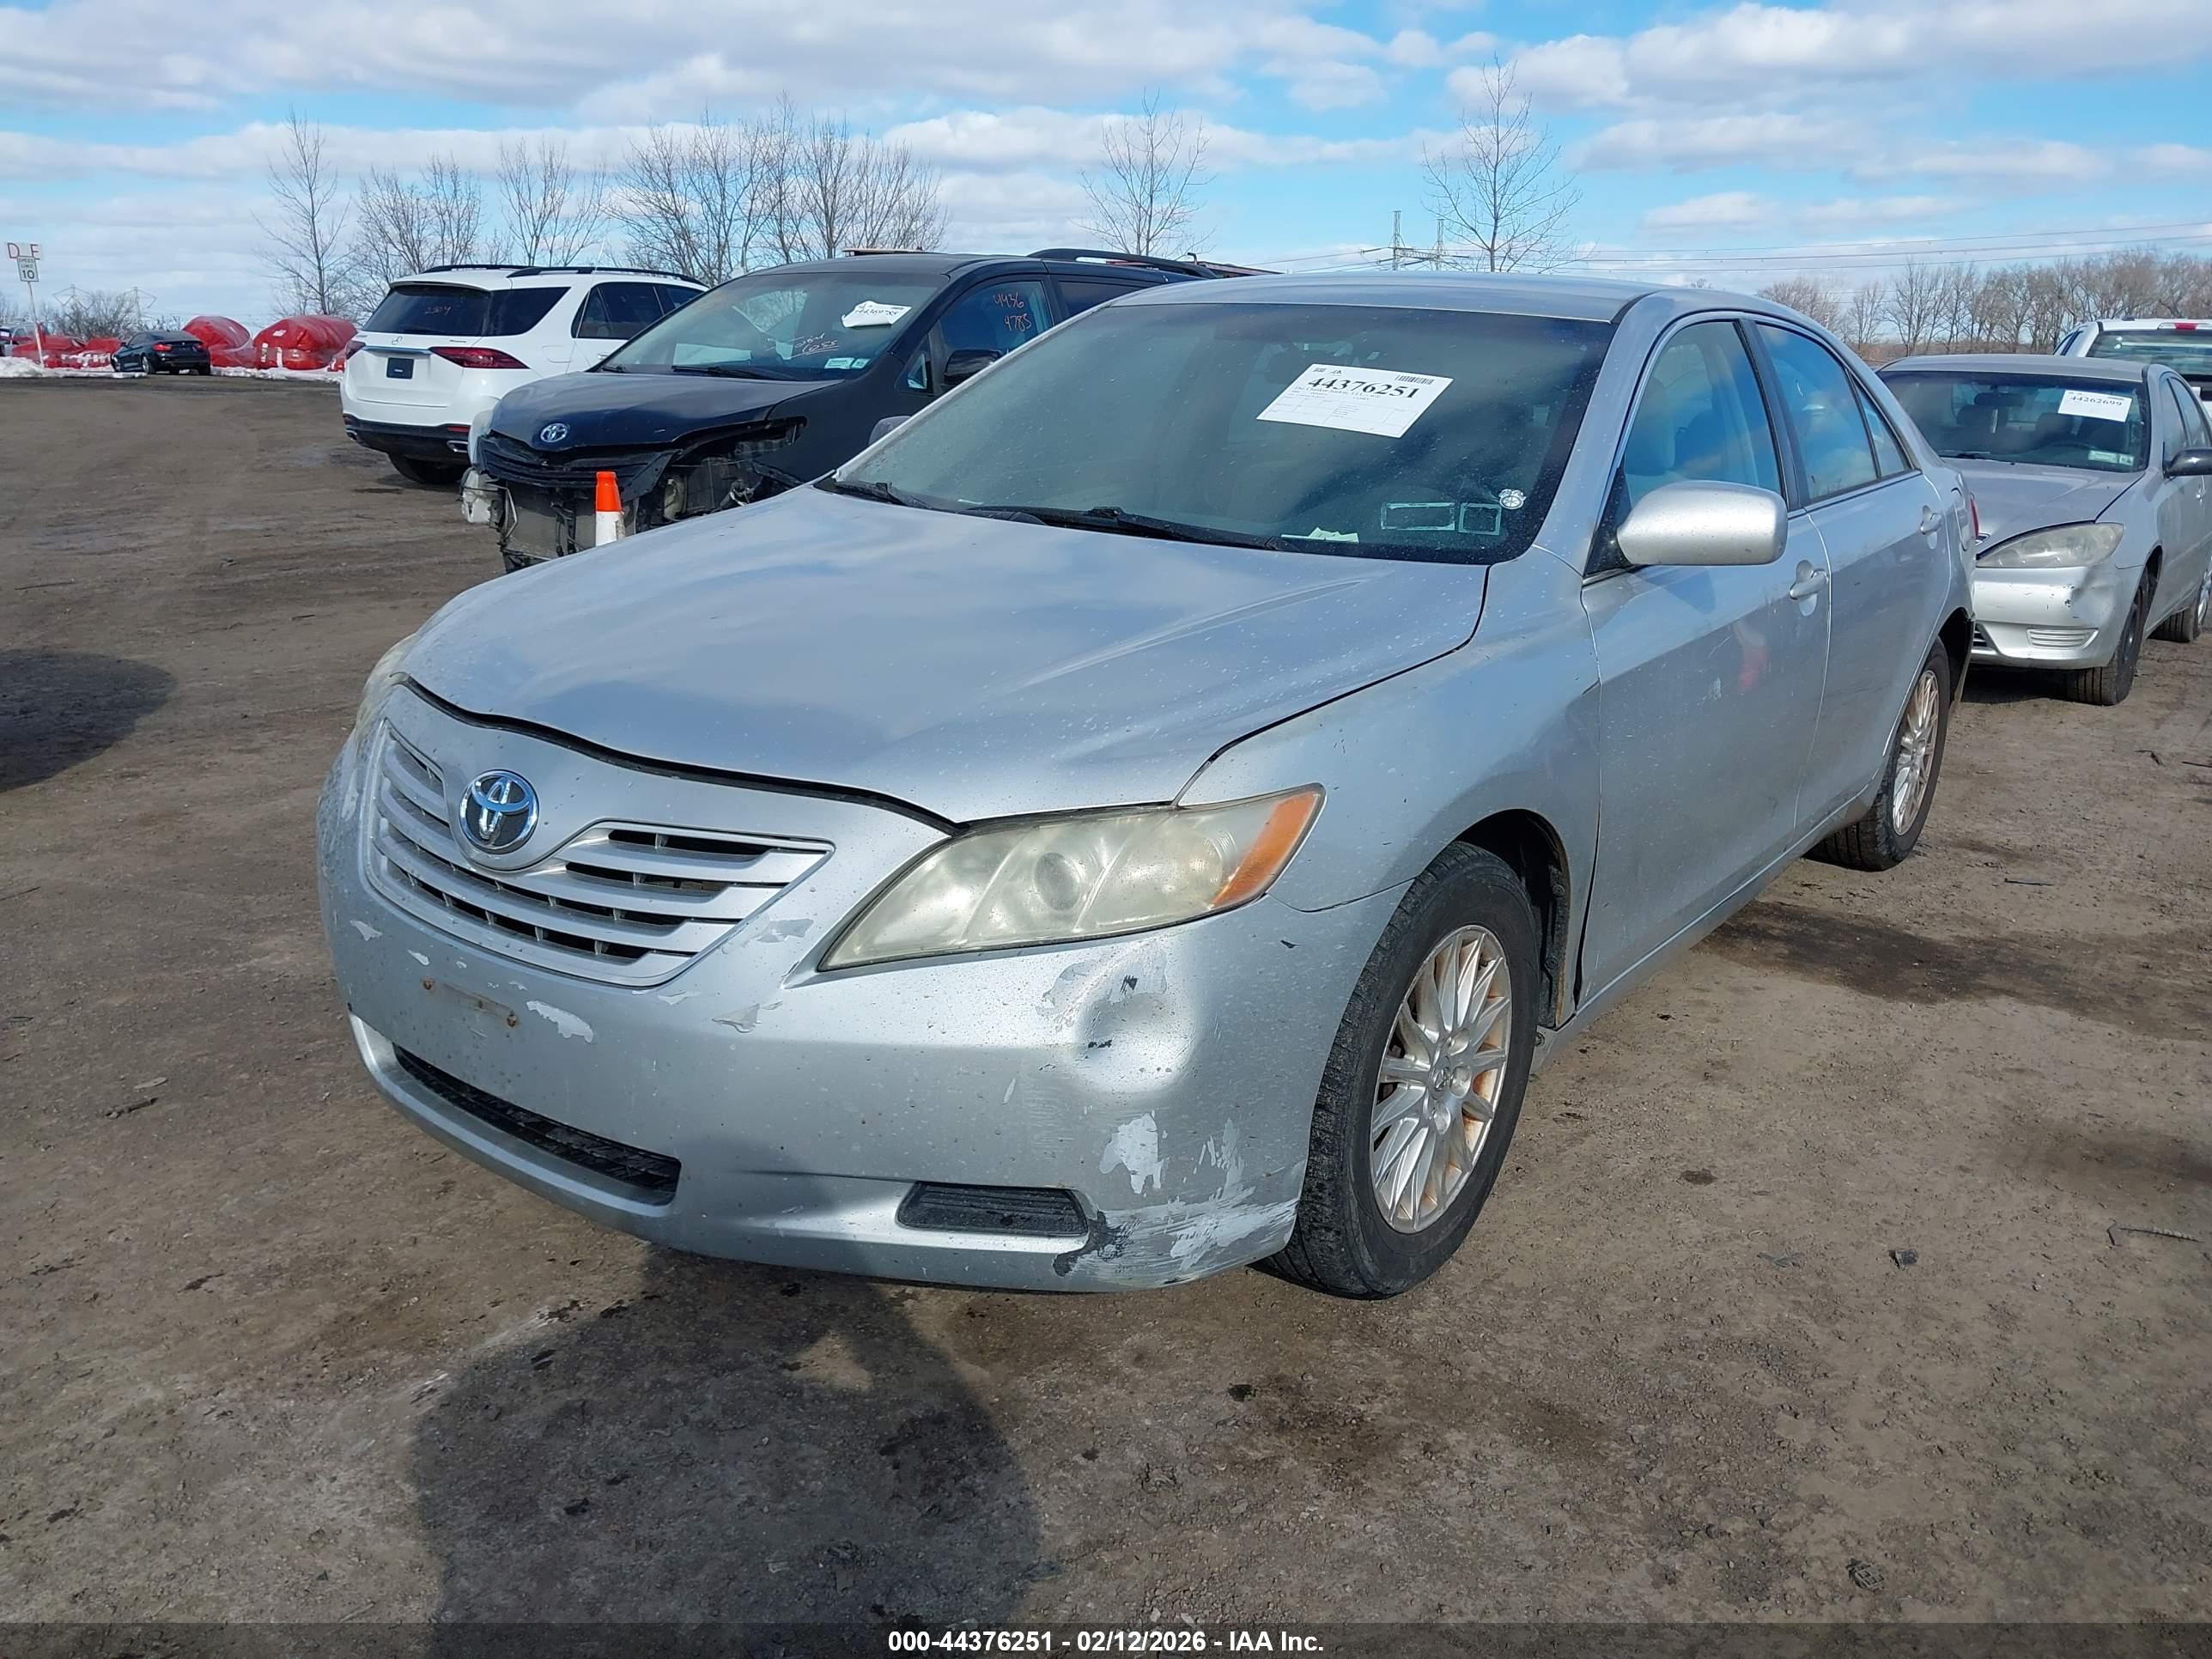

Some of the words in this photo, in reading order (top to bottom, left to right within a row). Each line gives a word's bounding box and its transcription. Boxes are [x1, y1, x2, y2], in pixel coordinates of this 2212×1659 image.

[7, 243, 20, 258] D
[30, 244, 40, 260] E
[22, 269, 35, 279] 10
[993, 291, 1024, 308] 4436
[1005, 313, 1031, 331] 4785
[1308, 377, 1420, 398] 44376251
[2069, 396, 2123, 405] 44262699
